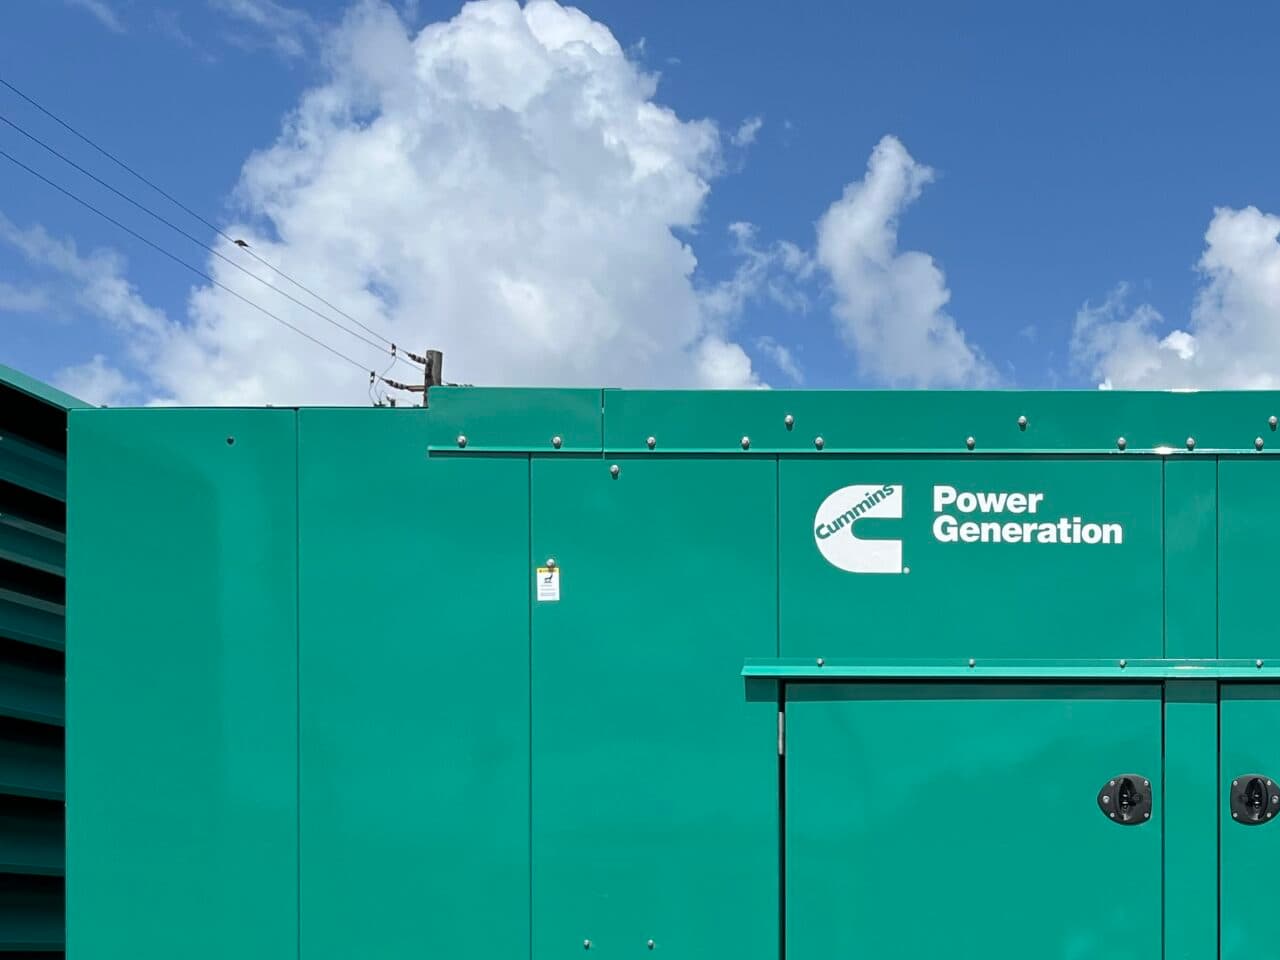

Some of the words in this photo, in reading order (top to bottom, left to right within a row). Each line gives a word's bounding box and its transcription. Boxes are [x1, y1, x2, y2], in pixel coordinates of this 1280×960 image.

[815, 484, 895, 540] Cummins
[932, 484, 1044, 513] Power
[932, 514, 1123, 545] Generation
